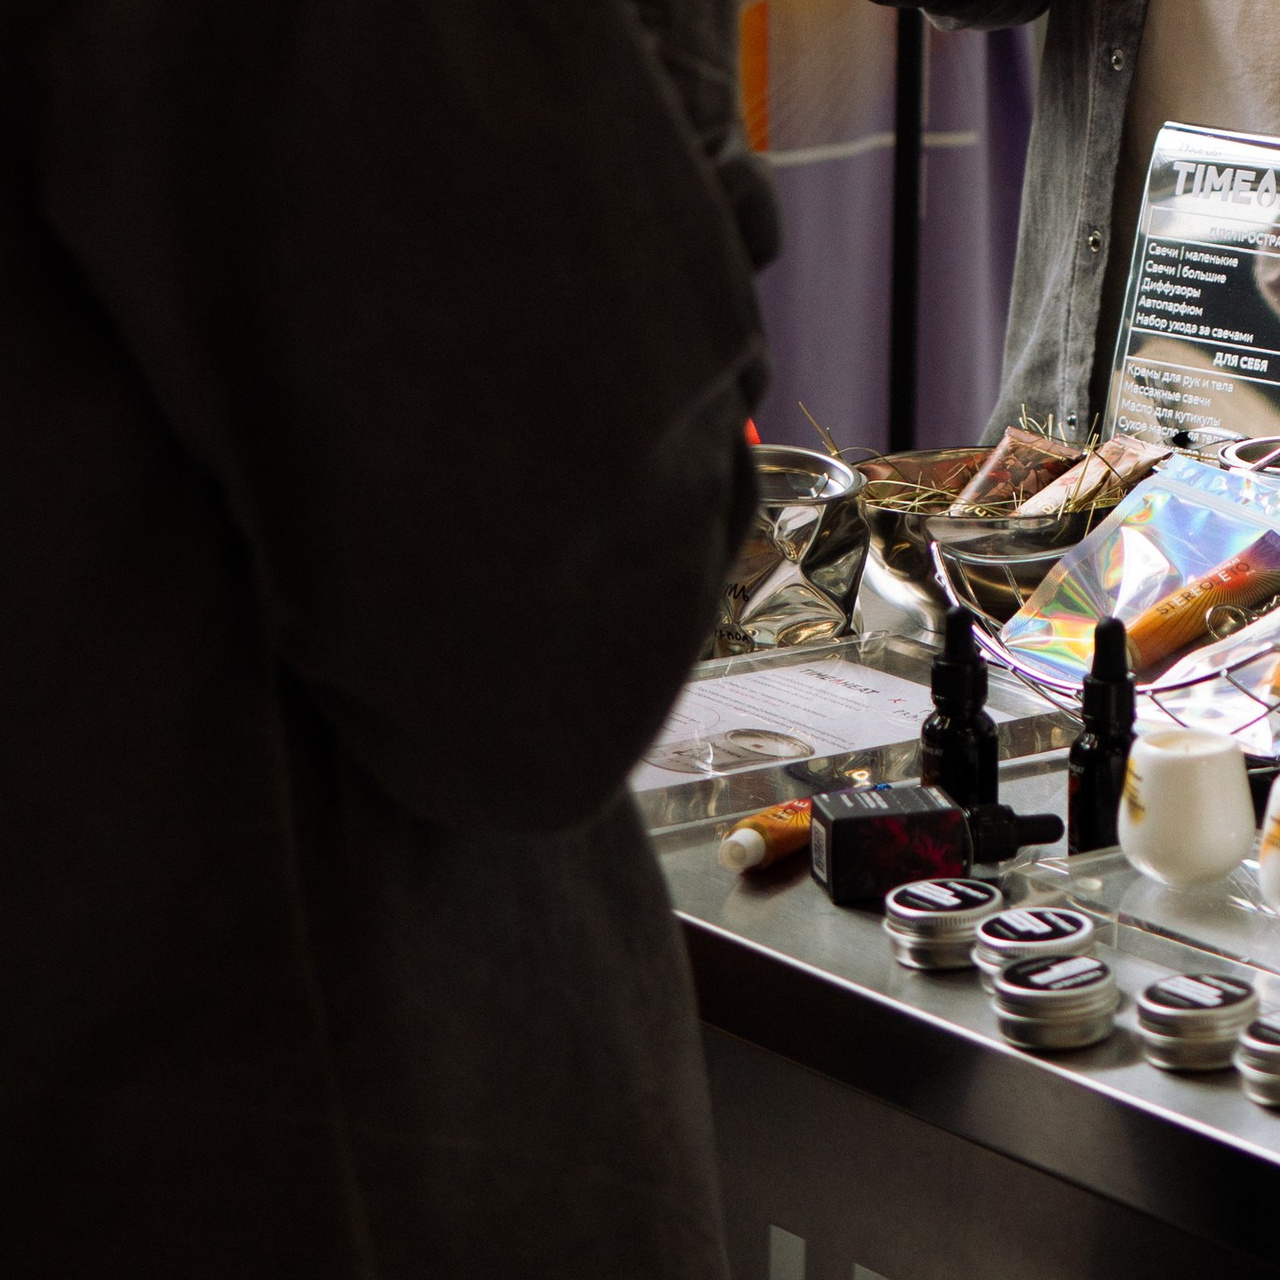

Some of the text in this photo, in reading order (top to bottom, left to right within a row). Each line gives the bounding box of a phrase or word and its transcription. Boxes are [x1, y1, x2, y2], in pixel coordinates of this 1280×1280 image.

[1148, 242, 1179, 259] Свечи
[1185, 250, 1239, 268] маленькие
[1145, 260, 1175, 276] Свечи
[1182, 265, 1227, 284] большие
[1141, 277, 1201, 299] Диффузоры
[1138, 295, 1203, 317] Автопарфюм
[1136, 312, 1254, 344] Набор ухода за свечами
[1213, 352, 1269, 373] ДЛЯ СЕБЯ
[1126, 362, 1234, 393] Кремы для рук и тела
[1124, 381, 1211, 407] Массажные свечи
[1121, 398, 1221, 427] Масло для кутикулы
